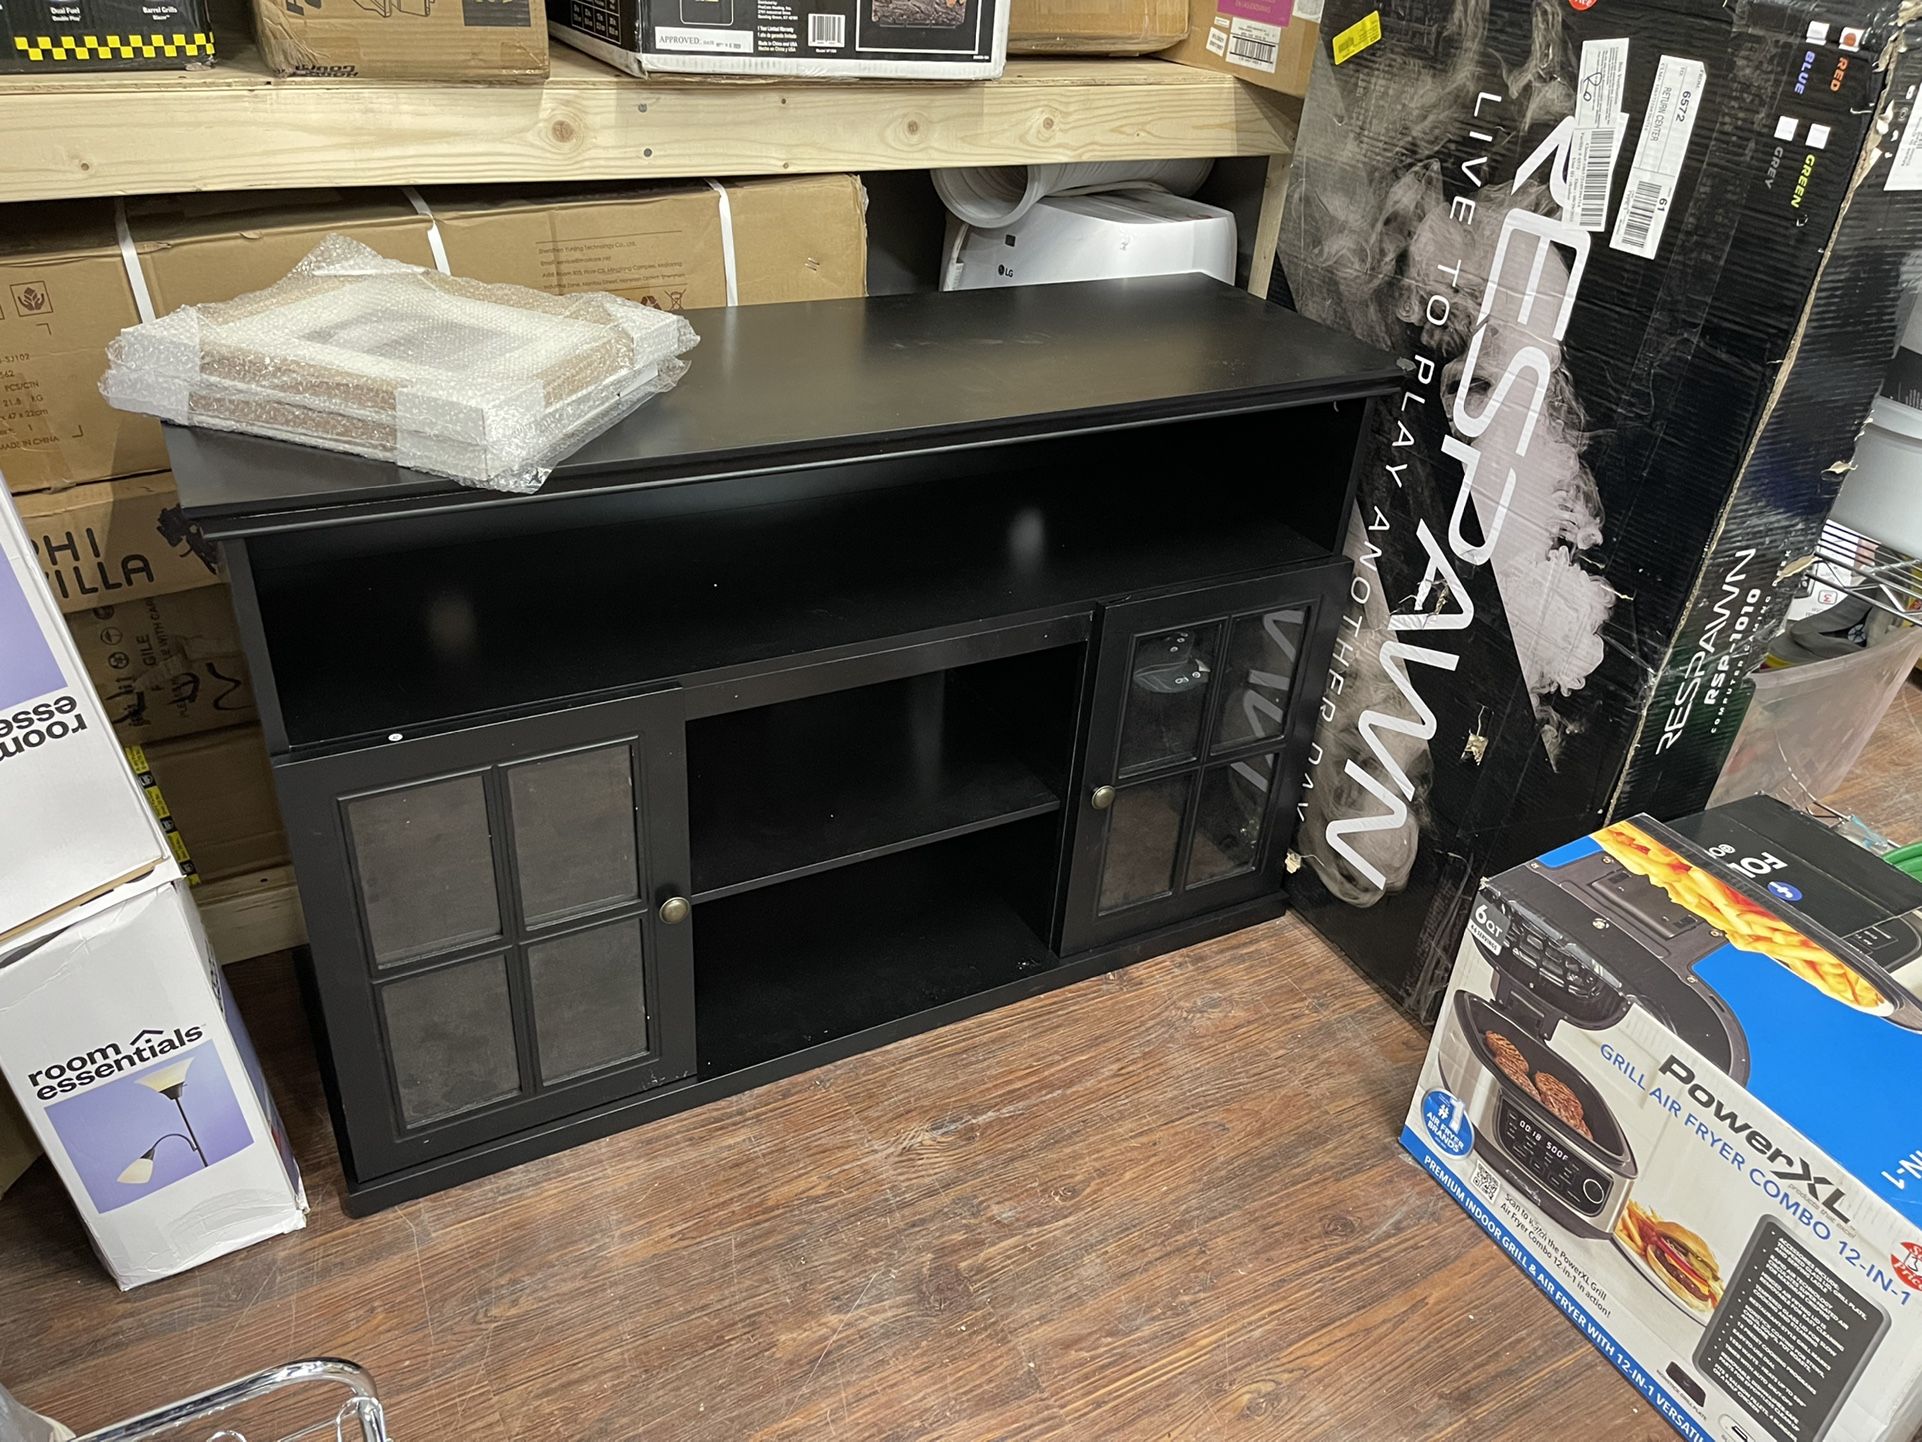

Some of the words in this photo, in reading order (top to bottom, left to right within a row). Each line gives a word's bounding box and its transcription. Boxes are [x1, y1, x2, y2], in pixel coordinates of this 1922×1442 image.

[1794, 51, 1816, 94] BLUE
[1830, 57, 1849, 92] RED
[1657, 86, 1671, 114] RETURN
[1674, 89, 1691, 122] 6572
[1649, 114, 1664, 142] CENTER
[1450, 92, 1501, 225] LIVE
[1765, 147, 1783, 189] GREY
[1790, 154, 1816, 208] GREEN
[1656, 197, 1668, 212] 61
[1005, 268, 1013, 278] LG
[1426, 259, 1461, 326] TO
[1385, 354, 1435, 488] PLAY
[1327, 113, 1629, 890] RESPAWN
[46, 554, 155, 599] ILLA
[1320, 505, 1389, 722] ANOTHER
[1656, 549, 1756, 755] RESPAWN
[1704, 588, 1761, 705] RSP-1010
[1711, 660, 1744, 734] COMPUTER
[1744, 596, 1772, 652] GAMING
[28, 1042, 122, 1087] room
[36, 1024, 203, 1101] essentials
[1426, 1112, 1440, 1126] AIR
[1440, 1124, 1465, 1150] FRYER
[1427, 1121, 1460, 1152] BRANDS
[1658, 1054, 1850, 1225] PowerXL
[1600, 1044, 1646, 1090] GRILL
[1649, 1087, 1682, 1117] AIR
[1684, 1112, 1746, 1172] FRYER
[1749, 1168, 1831, 1241] COMBO
[1837, 1240, 1911, 1306] 12-IN-1
[1788, 1183, 1820, 1211] products
[1500, 1203, 1510, 1216] Air
[1510, 1210, 1528, 1232] Fryer
[1528, 1230, 1552, 1259] Combo
[1577, 1280, 1585, 1293] in
[1585, 1290, 1611, 1318] action!
[1504, 1193, 1521, 1213] Scan
[1521, 1208, 1529, 1220] to
[1548, 1236, 1560, 1254] the
[1560, 1250, 1590, 1285] PowerXL
[1591, 1281, 1607, 1301] Grill
[1774, 1245, 1787, 1259] AND
[1787, 1256, 1810, 1278] SERVING
[1809, 1276, 1827, 1293] LADLE
[1778, 1236, 1815, 1269] ACCESSORIES
[1424, 1155, 1465, 1202] PREMIUM
[1464, 1197, 1502, 1240] INDOOR
[1502, 1236, 1529, 1268] GRILL
[1529, 1264, 1537, 1277] &
[1537, 1274, 1556, 1297] AIR
[1555, 1293, 1587, 1330] FRYER
[1587, 1323, 1616, 1357] WITH
[1617, 1353, 1655, 1397] 12-IN-1
[1760, 1271, 1782, 1291] HINGED
[1790, 1297, 1811, 1316] FRYING
[1765, 1263, 1777, 1275] FOR
[1776, 1273, 1805, 1299] MAXIMUM
[1804, 1296, 1830, 1321] CRISPING
[1767, 1258, 1799, 1287] CIRCULATES
[1769, 1254, 1786, 1270] RAPID
[1795, 1276, 1833, 1310] TECHNOLOGY
[1776, 1240, 1805, 1267] TEMPERED
[1804, 1265, 1823, 1282] GLASS
[1832, 1288, 1849, 1304] GRILL
[1740, 1312, 1753, 1326] AND
[1752, 1323, 1769, 1340] MORE
[1752, 1288, 1778, 1312] COOKING
[1777, 1310, 1790, 1323] AND
[1789, 1320, 1818, 1347] STEAMING
[1754, 1283, 1782, 1310] TEMPERED
[1781, 1307, 1799, 1324] GLASS
[1807, 1330, 1820, 1342] FOR
[1819, 1340, 1837, 1357] SLOW
[1759, 1275, 1791, 1305] REMOVABLE
[1790, 1303, 1802, 1315] FOR
[1801, 1312, 1816, 1327] EASY
[1815, 1324, 1844, 1352] CLEANING
[1724, 1343, 1740, 1359] TIMER
[1739, 1357, 1753, 1371] WITH
[1752, 1368, 1768, 1385] AUTO
[1741, 1347, 1758, 1365] WATTS
[1760, 1365, 1778, 1382] HEATS
[1742, 1326, 1762, 1346] PRESET
[1760, 1342, 1787, 1368] COOKING
[1785, 1365, 1817, 1395] PROGRAMS
[1762, 1355, 1776, 1369] DIAL
[1770, 1327, 1794, 1350] COATING
[1793, 1348, 1806, 1360] FOR
[1778, 1340, 1790, 1353] POT
[1795, 1338, 1811, 1354] GRILL
[1810, 1351, 1831, 1371] MARKS
[1714, 1363, 1725, 1375] FITS
[1728, 1376, 1750, 1398] SALMON
[1718, 1355, 1734, 1372] PARTS
[1733, 1369, 1745, 1382] FOR
[1744, 1379, 1774, 1409] EFFORTLESS
[1724, 1378, 1737, 1392] HALF
